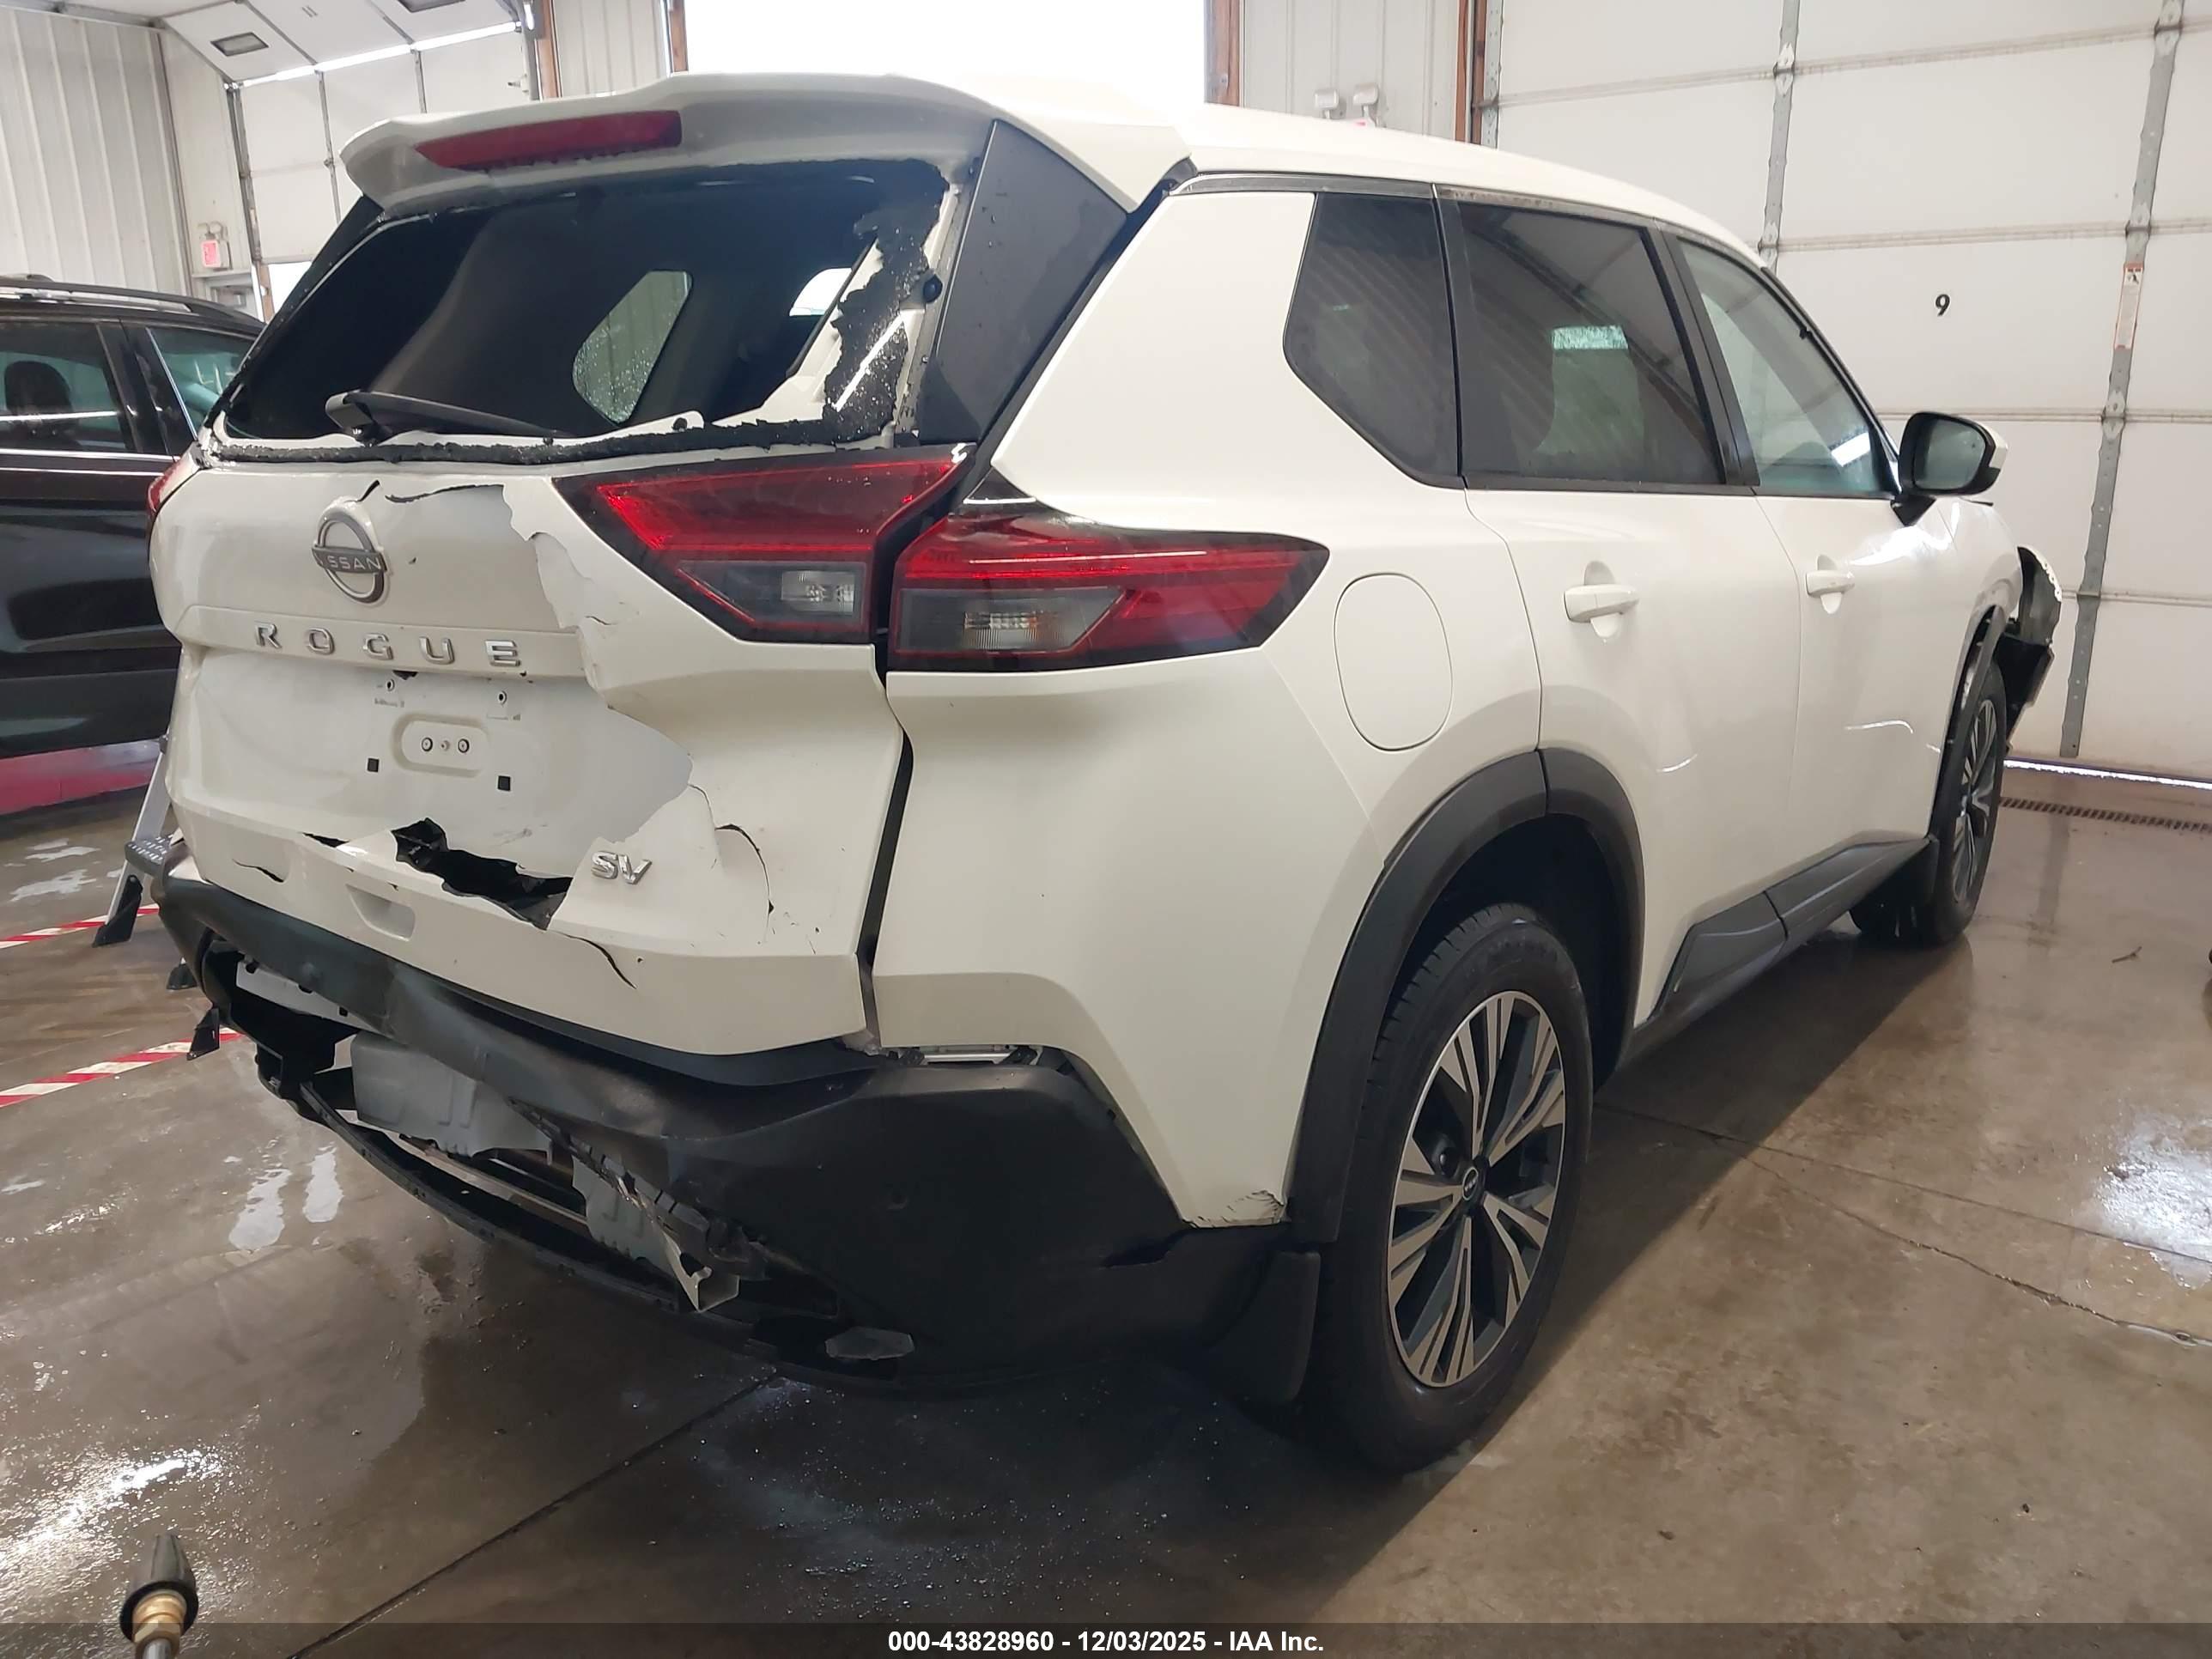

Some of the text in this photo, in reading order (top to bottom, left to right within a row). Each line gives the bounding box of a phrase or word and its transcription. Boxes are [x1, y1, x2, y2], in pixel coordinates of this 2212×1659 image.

[1935, 294, 1950, 317] 9
[314, 551, 382, 570] SSAN
[255, 621, 521, 667] ROGUE
[591, 851, 652, 885] SV
